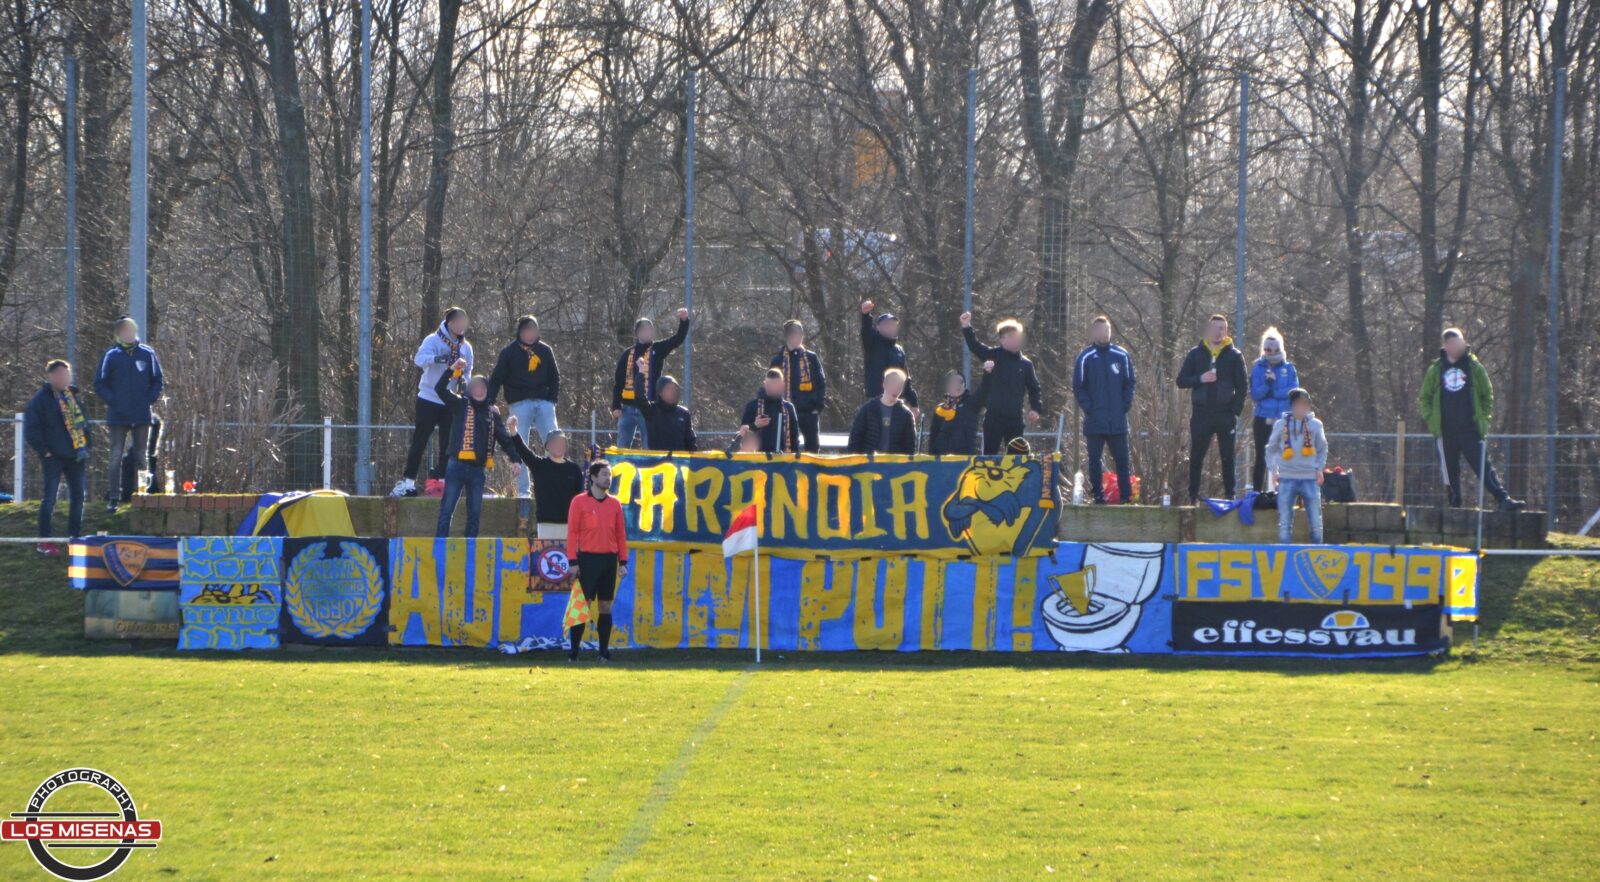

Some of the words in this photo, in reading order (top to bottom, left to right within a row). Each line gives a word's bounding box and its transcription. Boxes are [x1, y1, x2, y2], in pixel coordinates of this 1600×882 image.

[388, 537, 543, 648] AUF
[580, 549, 769, 649] UM
[1186, 550, 1287, 599] FSV
[1353, 552, 1477, 607] 1990
[1193, 620, 1417, 646] effessvau
